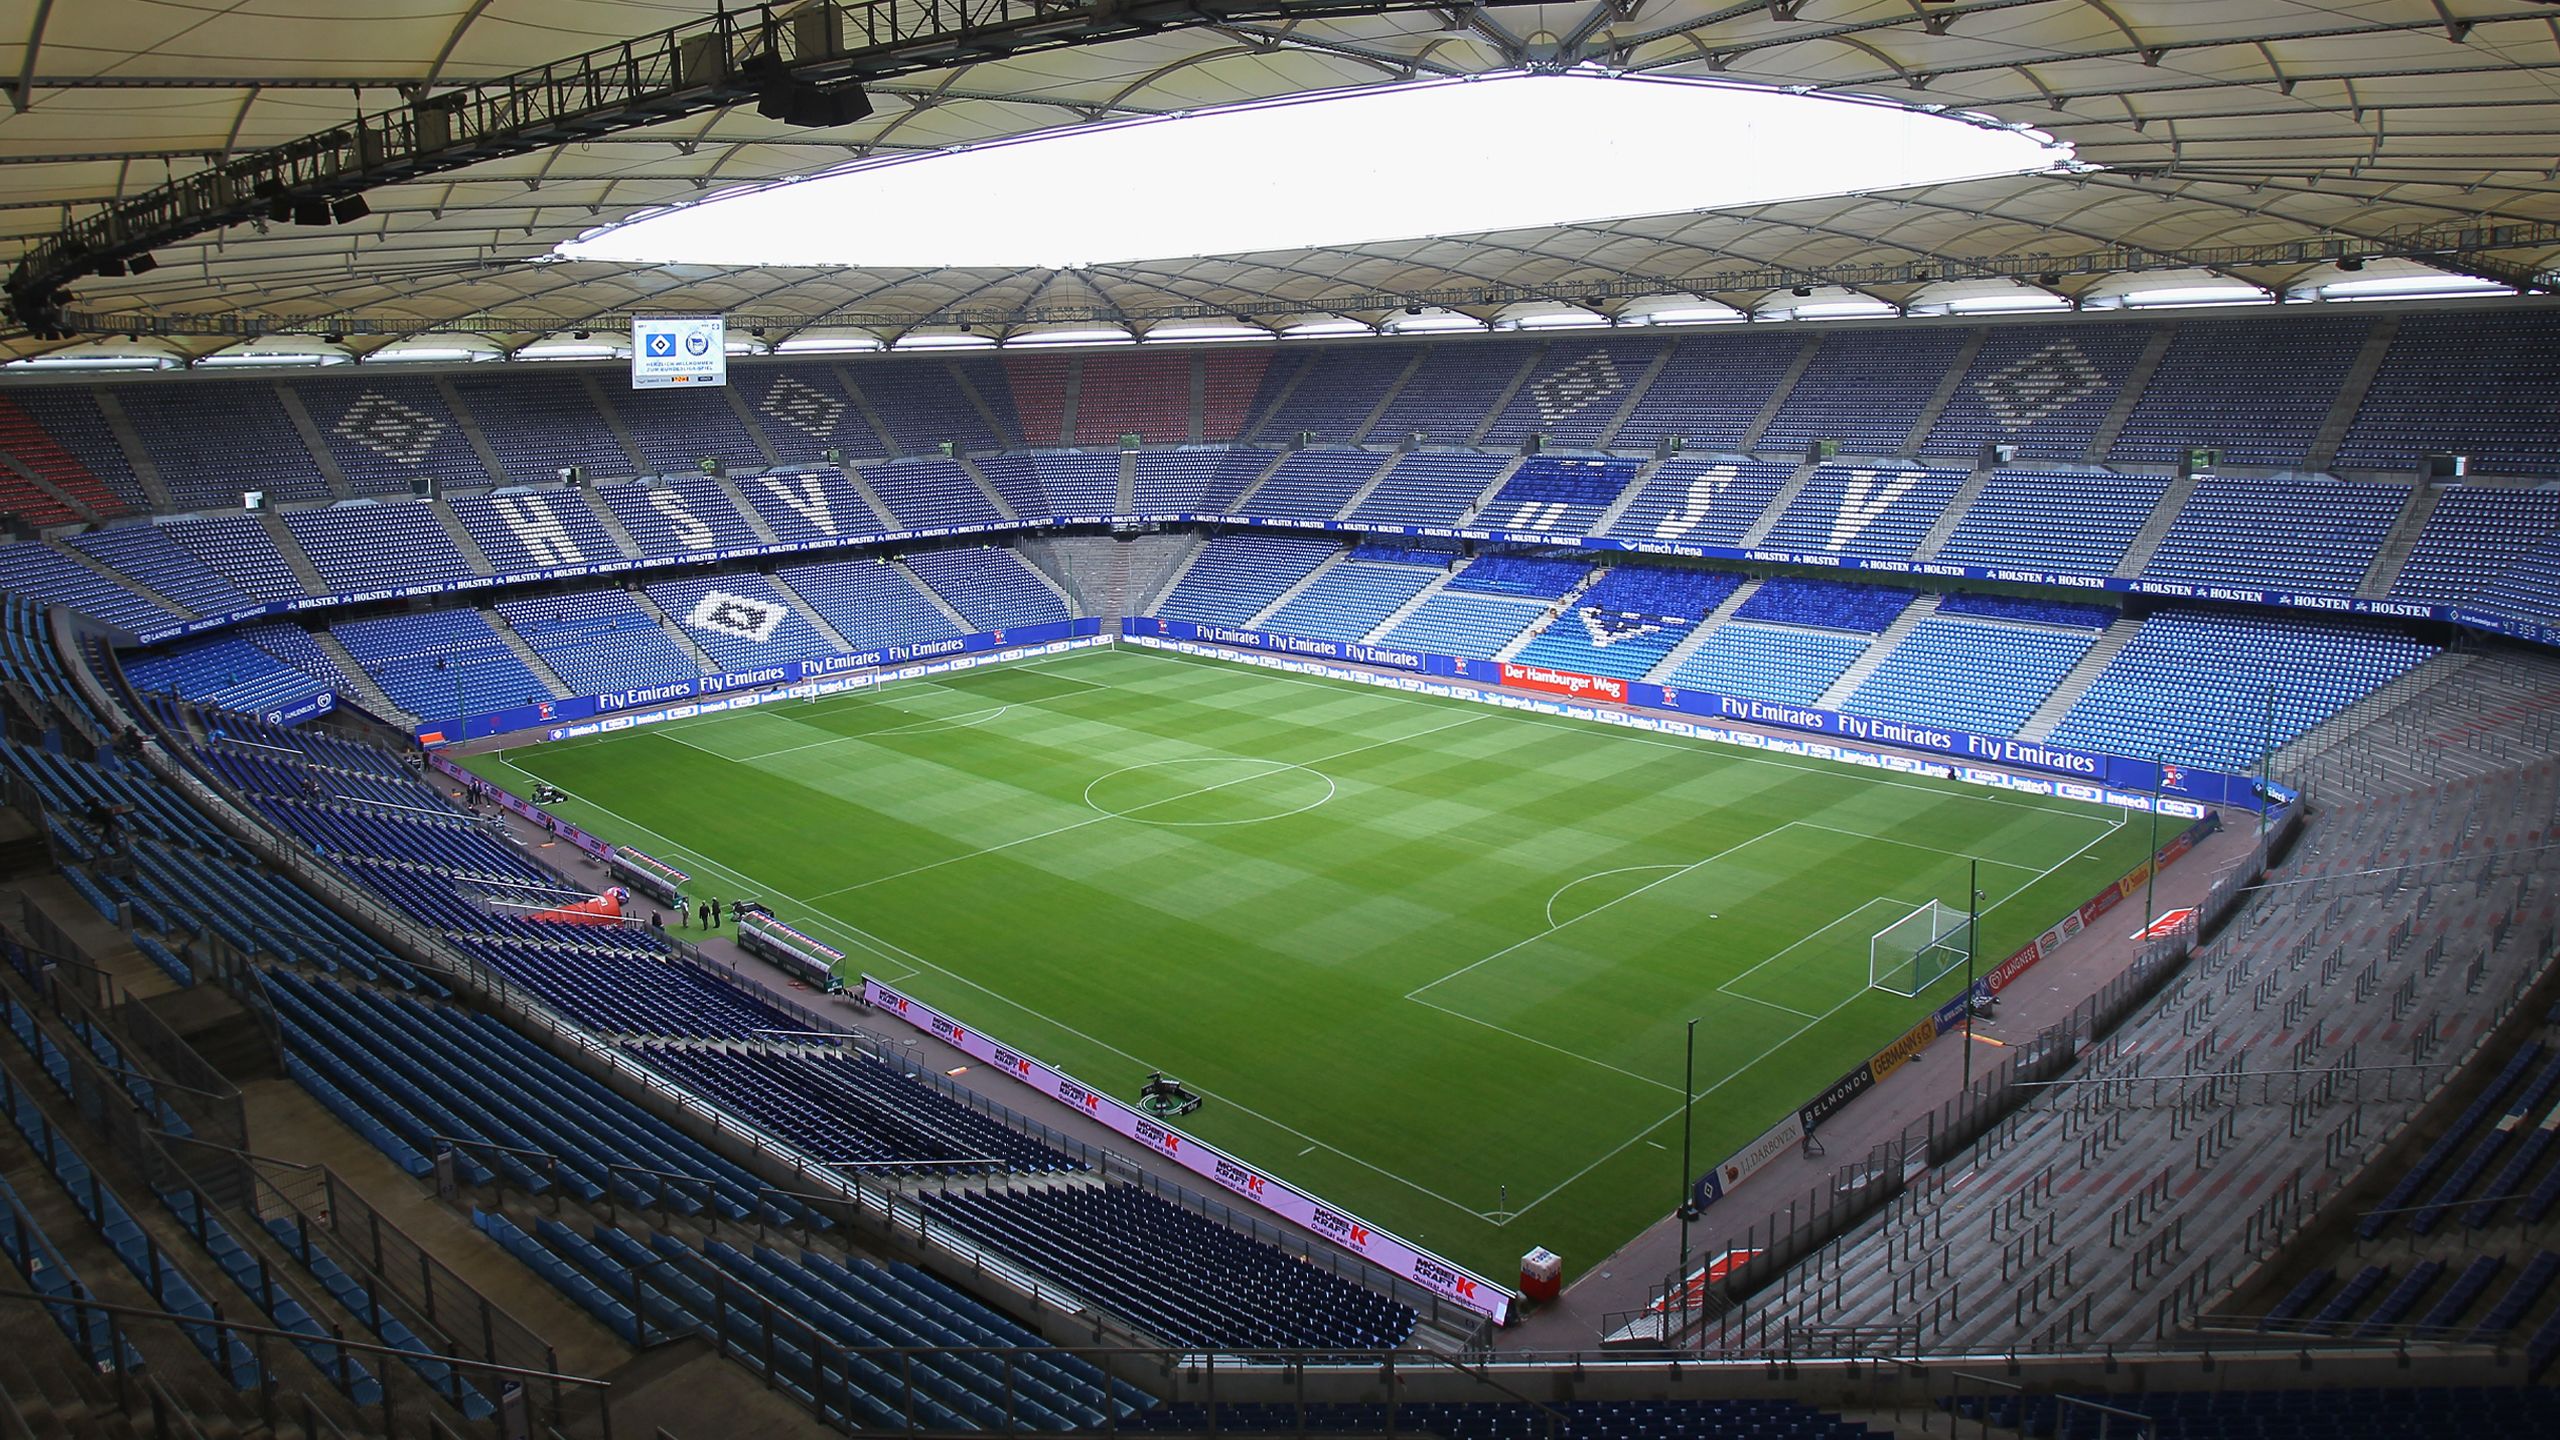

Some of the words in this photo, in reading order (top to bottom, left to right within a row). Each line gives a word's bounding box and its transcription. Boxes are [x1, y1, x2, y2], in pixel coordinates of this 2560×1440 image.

[1638, 543, 1671, 555] Imtech
[1672, 545, 1702, 556] Arena
[1754, 551, 1790, 563] HOLSTEN
[1802, 554, 1840, 566] HOLSTEN
[299, 597, 338, 608] HOLSTEN
[354, 590, 392, 602] HOLSTEN
[406, 584, 444, 596] HOLSTEN
[458, 578, 493, 590] HOLSTEN
[506, 572, 540, 583] HOLSTEN
[554, 567, 587, 578] HOLSTEN
[599, 562, 632, 572] HOLSTEN
[644, 557, 675, 567] HOLSTEN
[686, 552, 717, 562] HOLSTEN
[728, 548, 758, 558] HOLSTEN
[769, 544, 798, 553] HOLSTEN
[809, 540, 837, 549] HOLSTEN
[1870, 560, 1909, 572] HOLSTEN
[1923, 563, 1965, 577] HOLSTEN
[1998, 570, 2042, 583] HOLSTEN
[2058, 575, 2104, 588] HOLSTEN
[2142, 582, 2192, 596] HOLSTEN
[2210, 588, 2262, 602] HOLSTEN
[2294, 595, 2350, 610] HOLSTEN
[2371, 602, 2431, 618] HOLSTEN
[152, 627, 182, 641] LANGNESE
[1197, 626, 1214, 641] Fly
[1216, 628, 1260, 644] Emirates
[889, 647, 909, 660] Fly
[912, 639, 964, 656] Emirates
[1269, 634, 1286, 651] Fly
[1289, 637, 1336, 656] Emirates
[1346, 644, 1364, 662] Fly
[1367, 647, 1418, 666] Emirates
[801, 660, 823, 675] Fly
[826, 652, 880, 671] Emirates
[700, 677, 723, 691] Fly
[726, 667, 784, 687] Emirates
[1505, 665, 1523, 679] Der
[1527, 666, 1590, 692] Hamburger
[1593, 677, 1620, 698] Weg
[600, 692, 624, 709] Fly
[628, 682, 690, 700] Emirates
[1722, 697, 1748, 719] Fly
[1751, 701, 1823, 728] Emirates
[1838, 715, 1867, 738] Fly
[1871, 720, 1951, 748] Emirates
[1968, 735, 2000, 760] Fly
[2005, 741, 2095, 772] Emirates
[2107, 792, 2149, 809] Imtech
[2002, 947, 2036, 979] LANGNESE
[1018, 1059, 1031, 1075] K
[1085, 1093, 1100, 1110] K
[1805, 1071, 1868, 1122] BELMONDO
[1136, 1126, 1163, 1143] KRAFT
[1138, 1120, 1165, 1138] MÖBEL
[1165, 1134, 1180, 1152] K
[1215, 1167, 1246, 1186] KRAFT
[1217, 1160, 1249, 1180] MÖBEL
[1248, 1175, 1266, 1195] K
[1312, 1214, 1348, 1236] KRAFT
[1314, 1208, 1351, 1231] MÖBEL
[1311, 1223, 1335, 1238] Qualität
[1350, 1225, 1370, 1246] K
[1414, 1264, 1454, 1288] KRAFT
[1417, 1258, 1456, 1284] MÖBEL
[1412, 1274, 1440, 1292] Qualität
[1456, 1277, 1478, 1299] K
